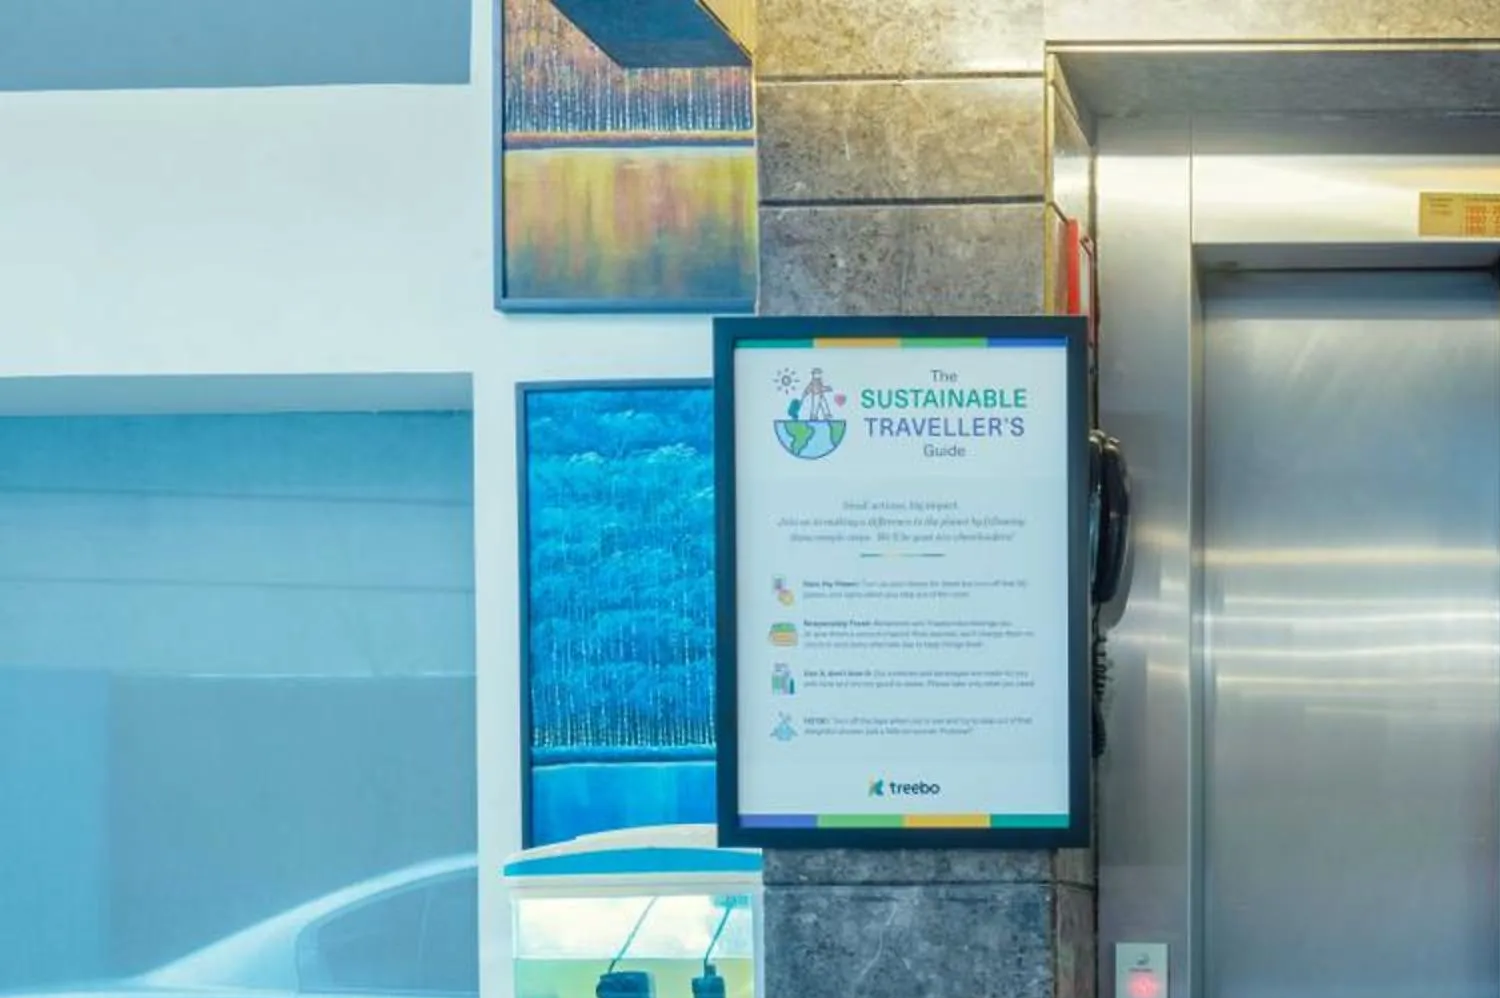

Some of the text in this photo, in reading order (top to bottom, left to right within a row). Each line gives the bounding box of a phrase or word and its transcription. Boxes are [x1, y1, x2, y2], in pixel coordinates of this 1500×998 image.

[931, 369, 958, 383] The
[861, 388, 1028, 409] SUSTAINABLE
[864, 416, 1026, 437] TRAVELLER'S
[923, 443, 967, 458] Guide
[889, 780, 941, 795] treebo
